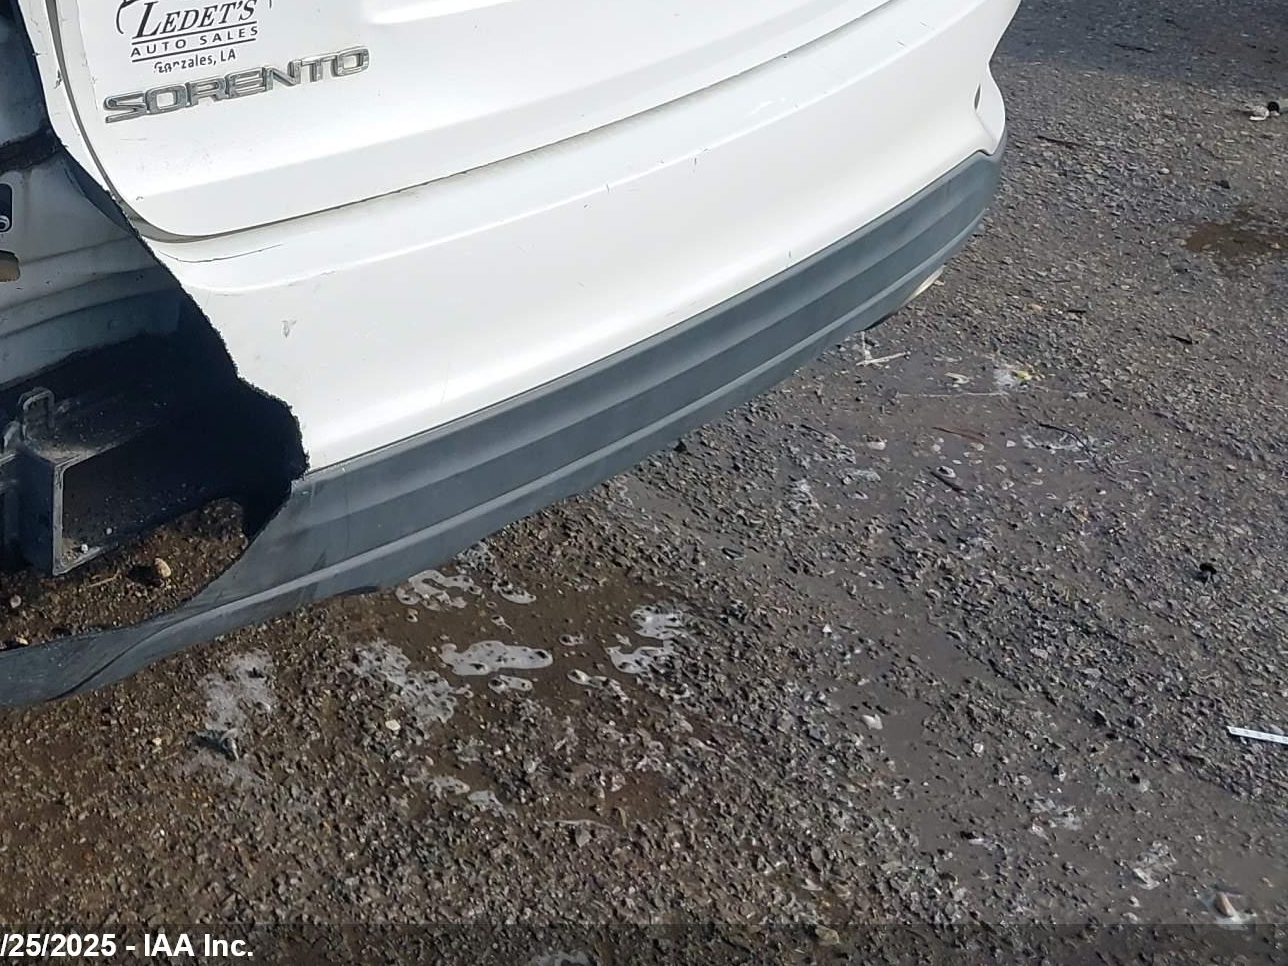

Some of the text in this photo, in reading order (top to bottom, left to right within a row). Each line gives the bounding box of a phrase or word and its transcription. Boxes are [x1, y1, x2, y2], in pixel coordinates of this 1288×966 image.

[130, 25, 259, 58] AUTO SALES
[220, 48, 236, 62] LA
[103, 45, 370, 124] SORENTO
